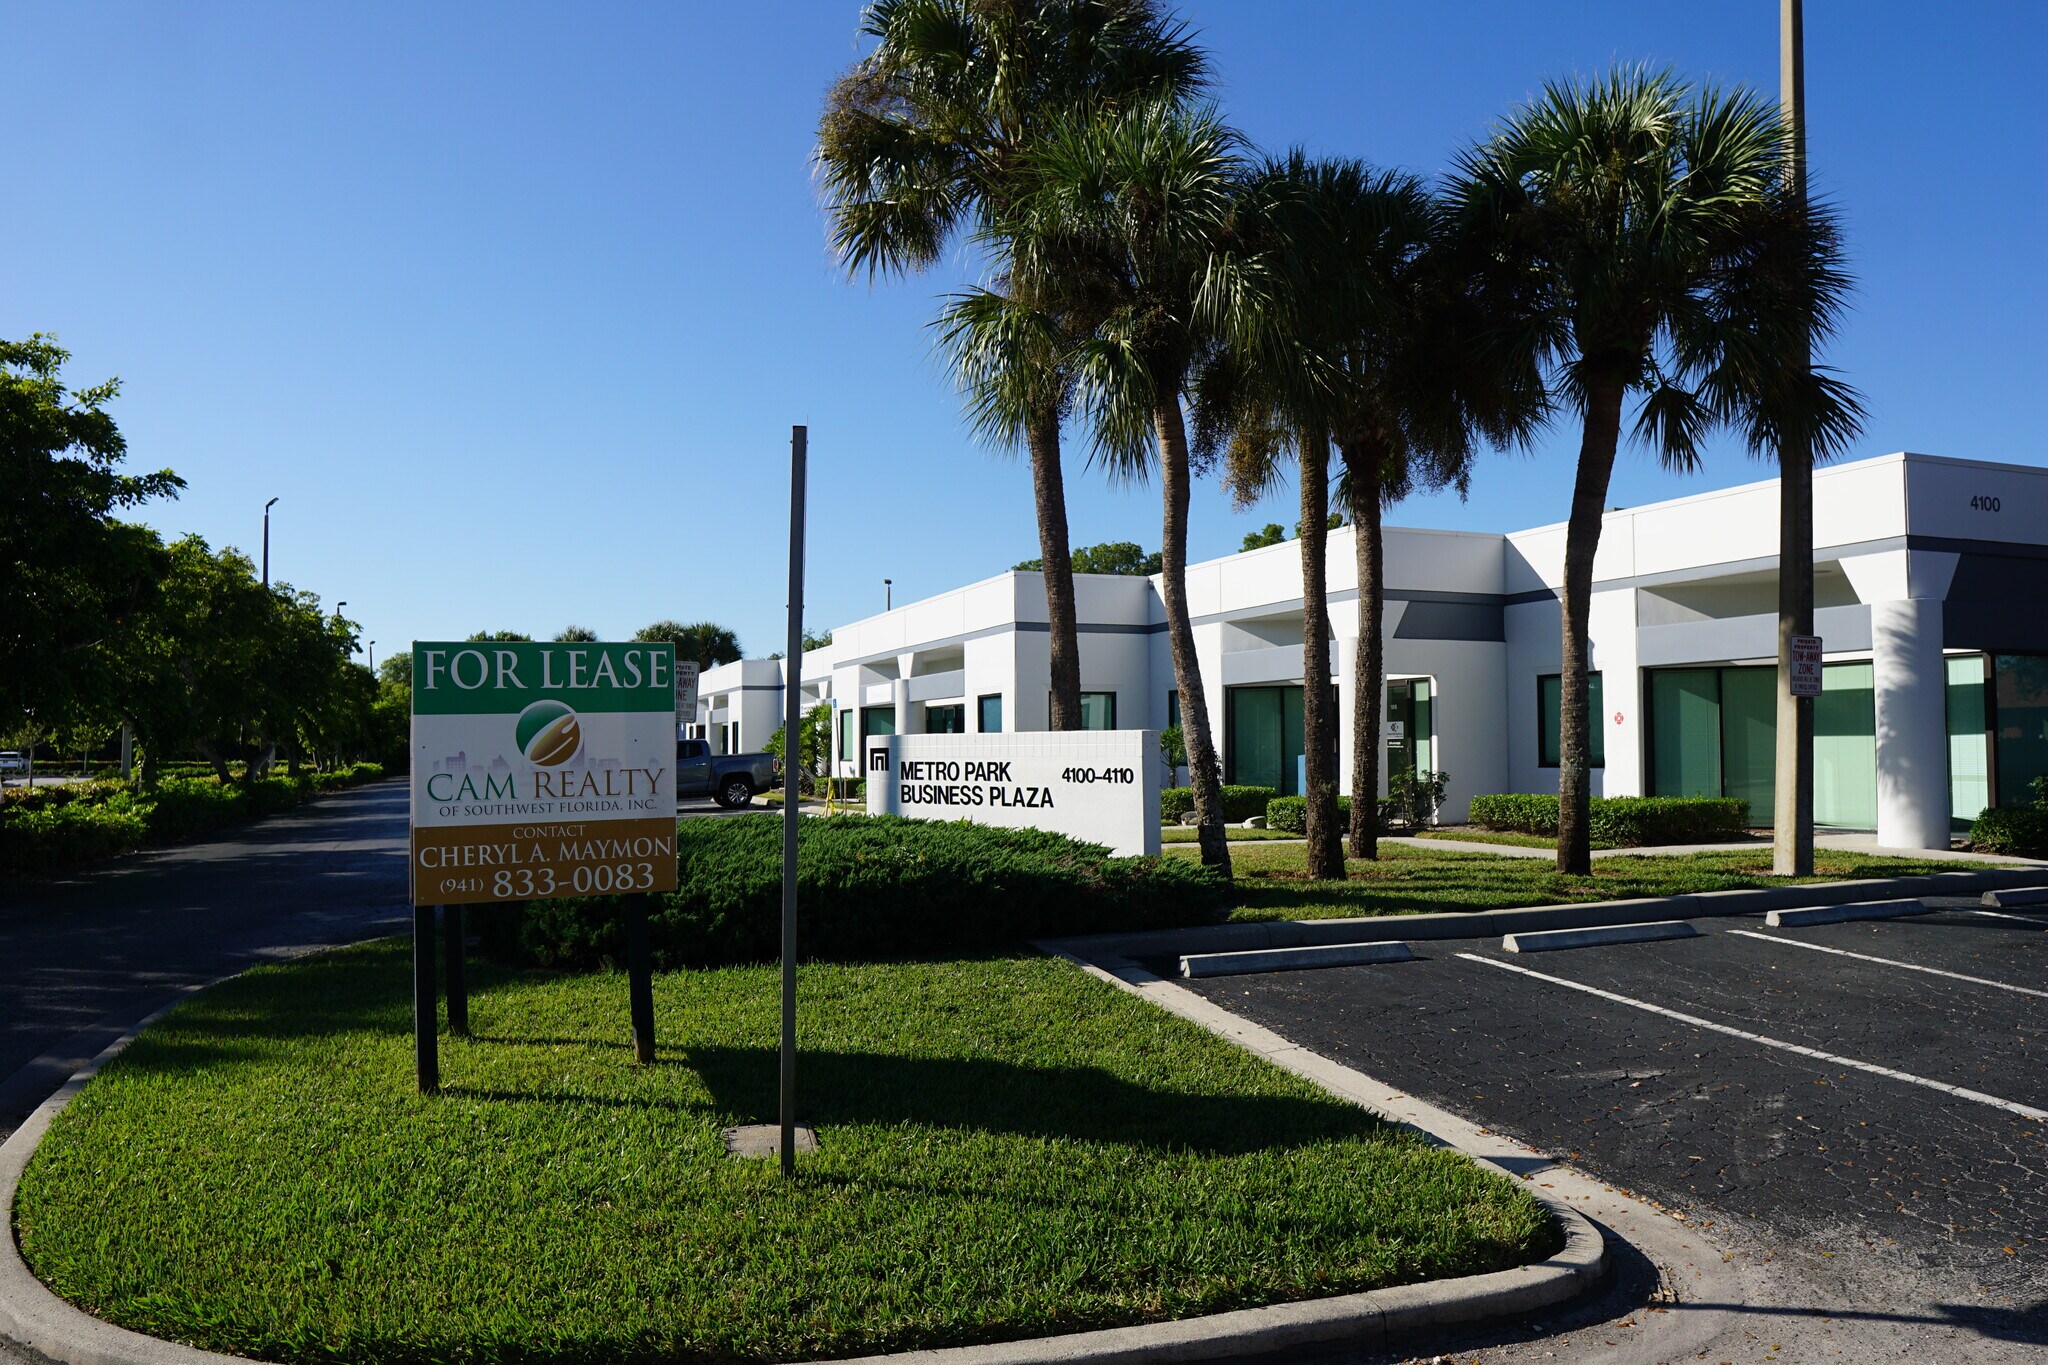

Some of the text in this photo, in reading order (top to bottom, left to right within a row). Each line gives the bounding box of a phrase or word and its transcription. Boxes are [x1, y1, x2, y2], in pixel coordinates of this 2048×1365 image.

[1970, 495, 2001, 512] 4100
[1792, 650, 1820, 663] TOW-AWAY
[423, 649, 669, 690] FOR LEASE
[1798, 663, 1814, 675] ZONE
[900, 761, 1012, 782] METRO PARK
[1061, 767, 1134, 785] 4100-4110
[427, 768, 666, 802] CAM REALTY
[900, 784, 1054, 808] BUSINESS PLAZA
[439, 798, 658, 818] OF SOUTHWEST FLORIDA, INC.
[513, 824, 586, 839] CONTACT
[419, 836, 672, 869] CHERYL A. MAYMON
[440, 863, 654, 898] (941) 833-0083
